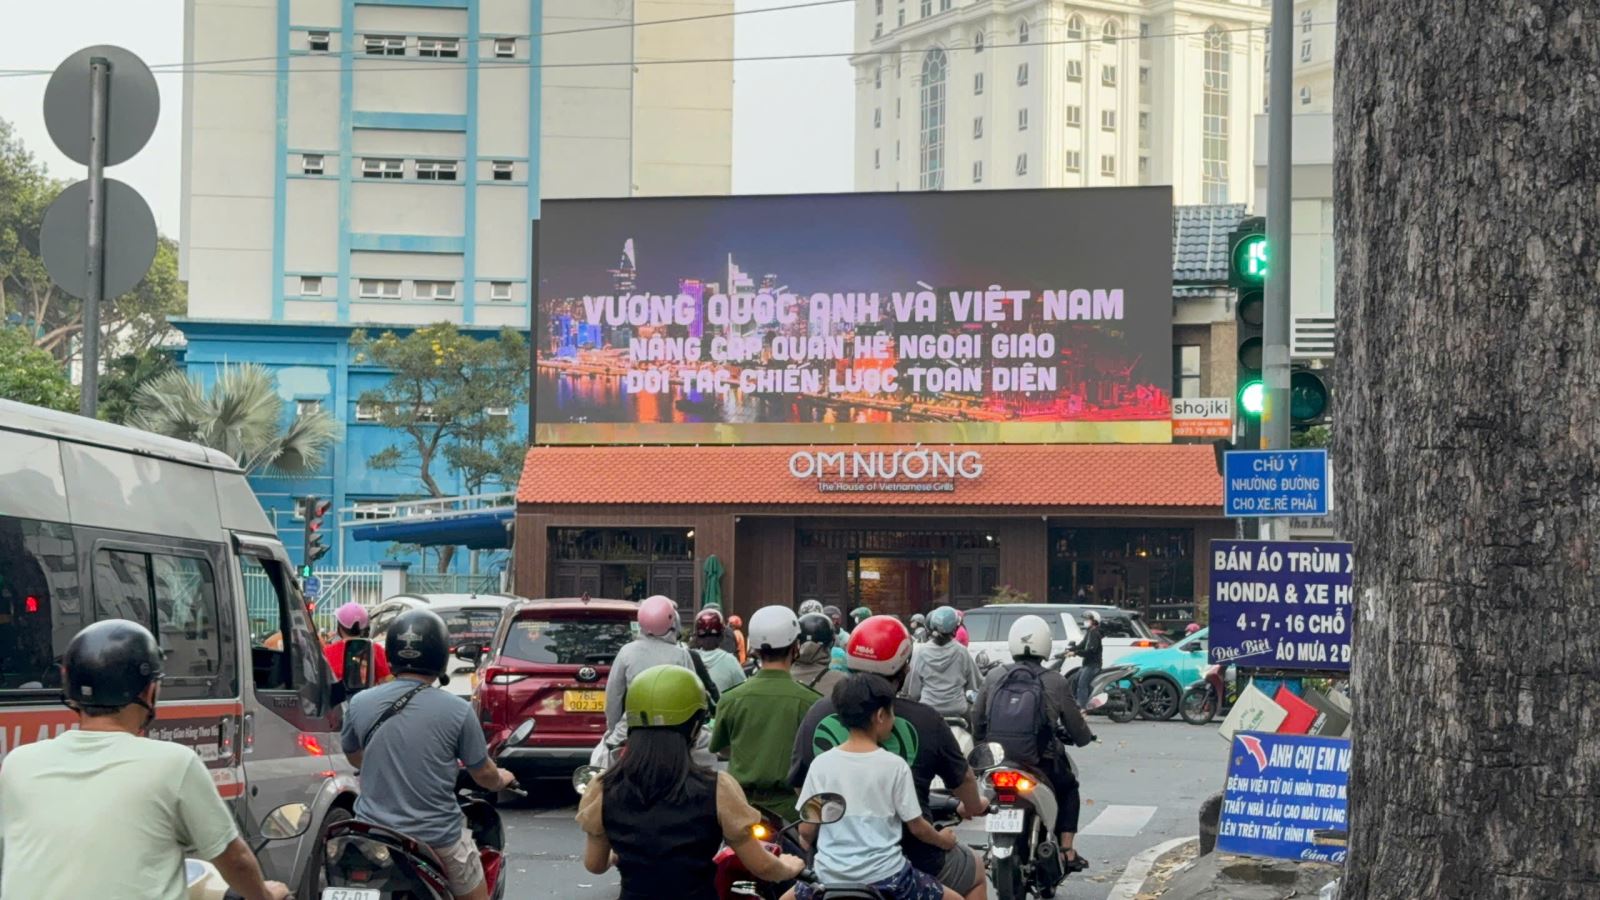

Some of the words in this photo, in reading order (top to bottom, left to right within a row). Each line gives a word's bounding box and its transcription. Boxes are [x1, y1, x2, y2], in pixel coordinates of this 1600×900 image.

[583, 292, 696, 326] VƯƠNG
[708, 285, 798, 326] QUỐC
[809, 292, 879, 323] ANH
[892, 280, 937, 323] VÀ
[949, 285, 1031, 329] VIỆT
[1043, 289, 1124, 321] NAM
[629, 333, 701, 361] NÂNG
[772, 336, 844, 361] QUAN
[854, 331, 889, 364] HỆ
[900, 334, 981, 364] NGOẠI
[991, 333, 1056, 359] GIAO
[740, 362, 820, 393] CHIẾN
[829, 367, 899, 397] LƯỢC
[907, 360, 982, 392] TOÀN
[992, 362, 1057, 397] DIỆN
[1174, 401, 1228, 417] shojiki
[1253, 454, 1284, 472] CHÚ
[1288, 454, 1298, 472] Ý
[818, 482, 836, 491] The
[837, 482, 864, 491] House
[866, 482, 877, 491] of
[879, 482, 932, 491] Vietnamese
[933, 482, 954, 491] Grills
[1232, 474, 1277, 491] NHƯỜNG
[1281, 474, 1320, 491] ĐƯỜNG
[1232, 497, 1255, 510] CHO
[1291, 493, 1317, 510] PHẢI
[1215, 545, 1252, 571] BÁN
[1257, 546, 1283, 572] ÁO
[1287, 547, 1340, 573] TRÙM
[1216, 581, 1280, 603] HONDA
[1285, 583, 1298, 604] &
[1304, 583, 1329, 604] XE
[1236, 613, 1247, 631] 4
[1261, 614, 1271, 632] 7
[1285, 614, 1305, 633] 16
[1309, 607, 1345, 634] CHỖ
[1241, 638, 1271, 654] Biệt
[1276, 636, 1295, 660] ÁO
[1298, 640, 1327, 662] MƯA
[1330, 644, 1339, 662] 2
[1268, 744, 1294, 768] ANH
[1295, 745, 1316, 775] CHỊ
[1316, 747, 1337, 771] EM
[1227, 773, 1249, 794] BỆNH
[1250, 775, 1269, 796] VIỆN
[1294, 779, 1314, 797] NHÌN
[1315, 783, 1336, 799] THEO
[1224, 795, 1247, 814] THẤY
[1247, 799, 1264, 816] NHÀ
[1284, 804, 1301, 820] CAO
[1301, 802, 1321, 821] MÀU
[1322, 804, 1346, 823] VÀNG
[1219, 818, 1237, 837] LÊN
[1238, 820, 1260, 839] TRÊN
[1262, 821, 1285, 841] THẤY
[1285, 823, 1304, 842] HÌNH
